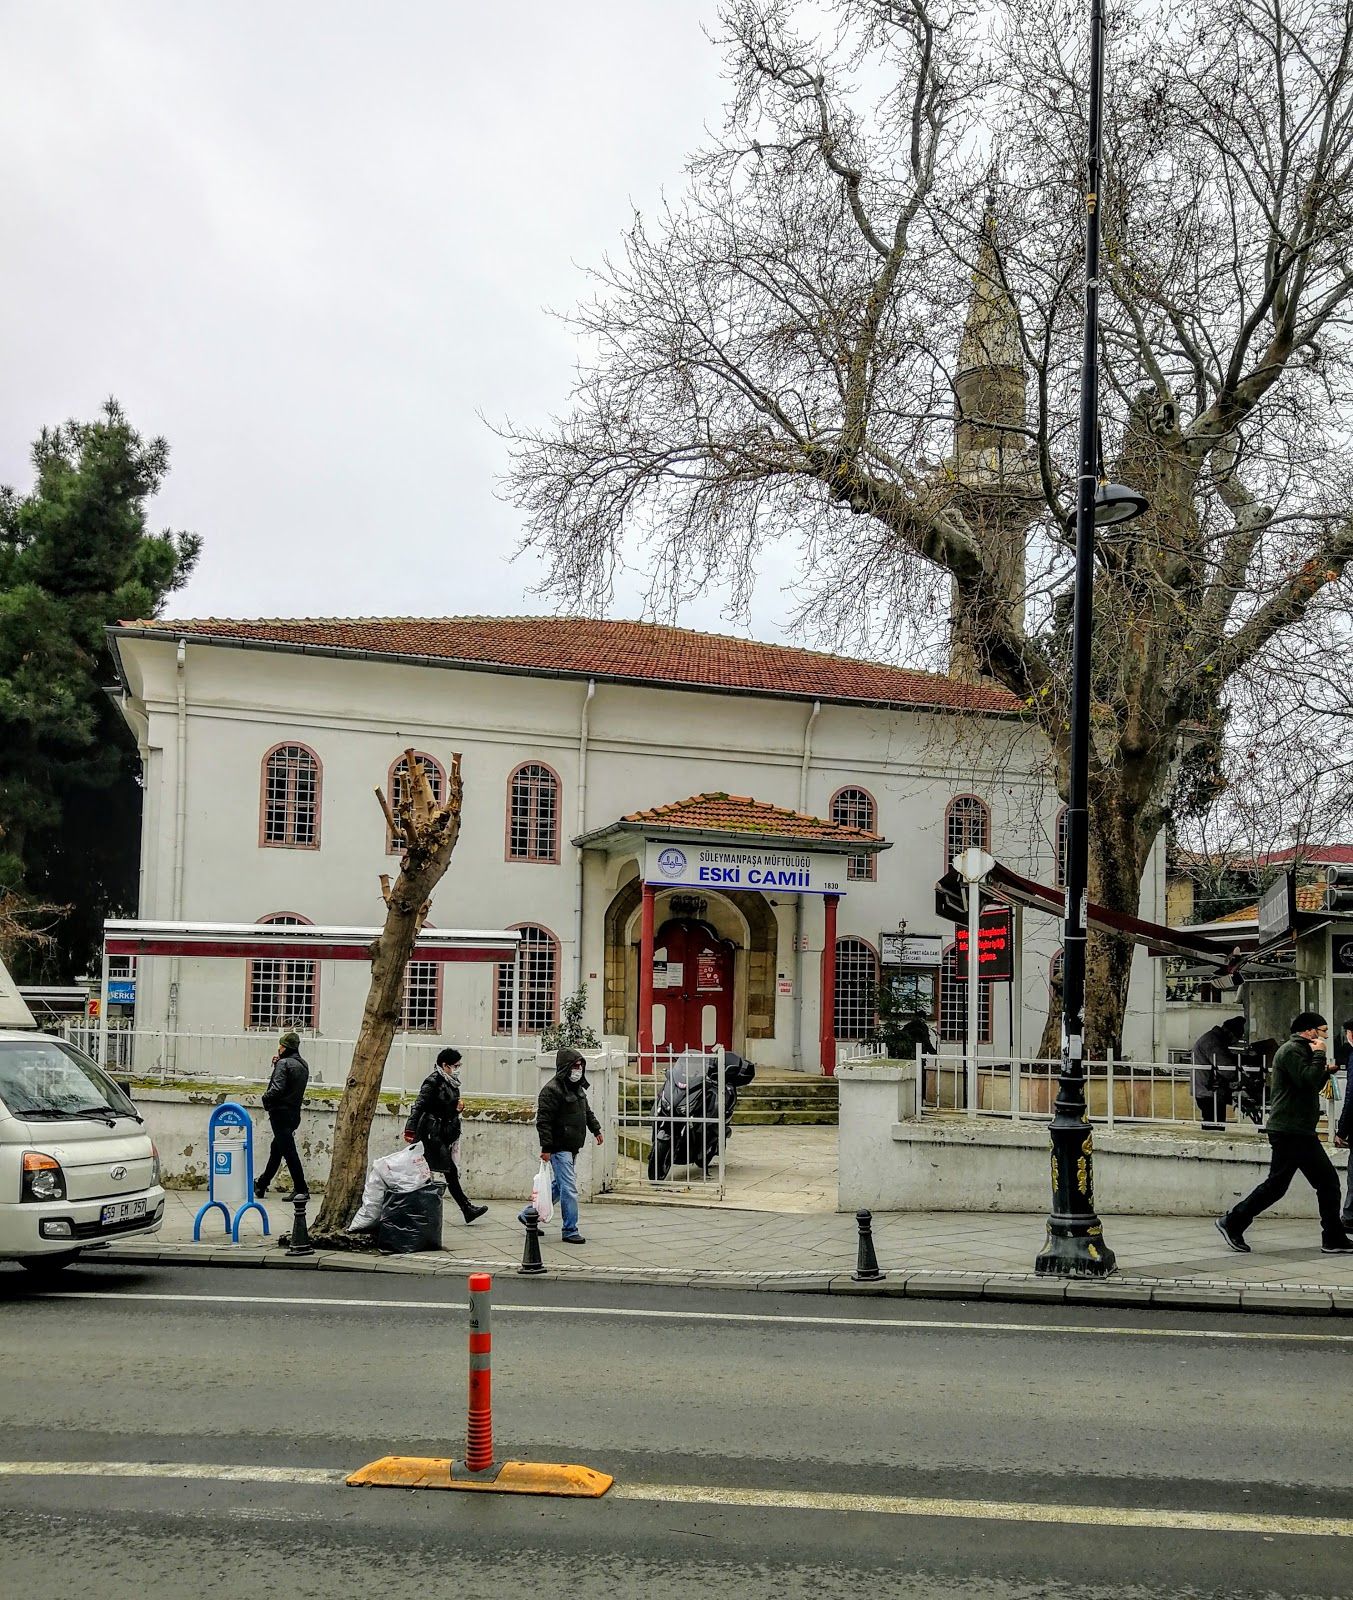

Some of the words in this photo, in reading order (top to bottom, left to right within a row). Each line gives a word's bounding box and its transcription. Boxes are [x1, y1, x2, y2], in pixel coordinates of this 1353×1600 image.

[700, 850, 762, 867] SÜLEYMANPAŞA
[764, 854, 811, 868] MÜFTÜLÜĞÜ
[700, 865, 740, 883] ESKİ
[748, 869, 810, 887] CAMİİ
[824, 882, 839, 890] 1830
